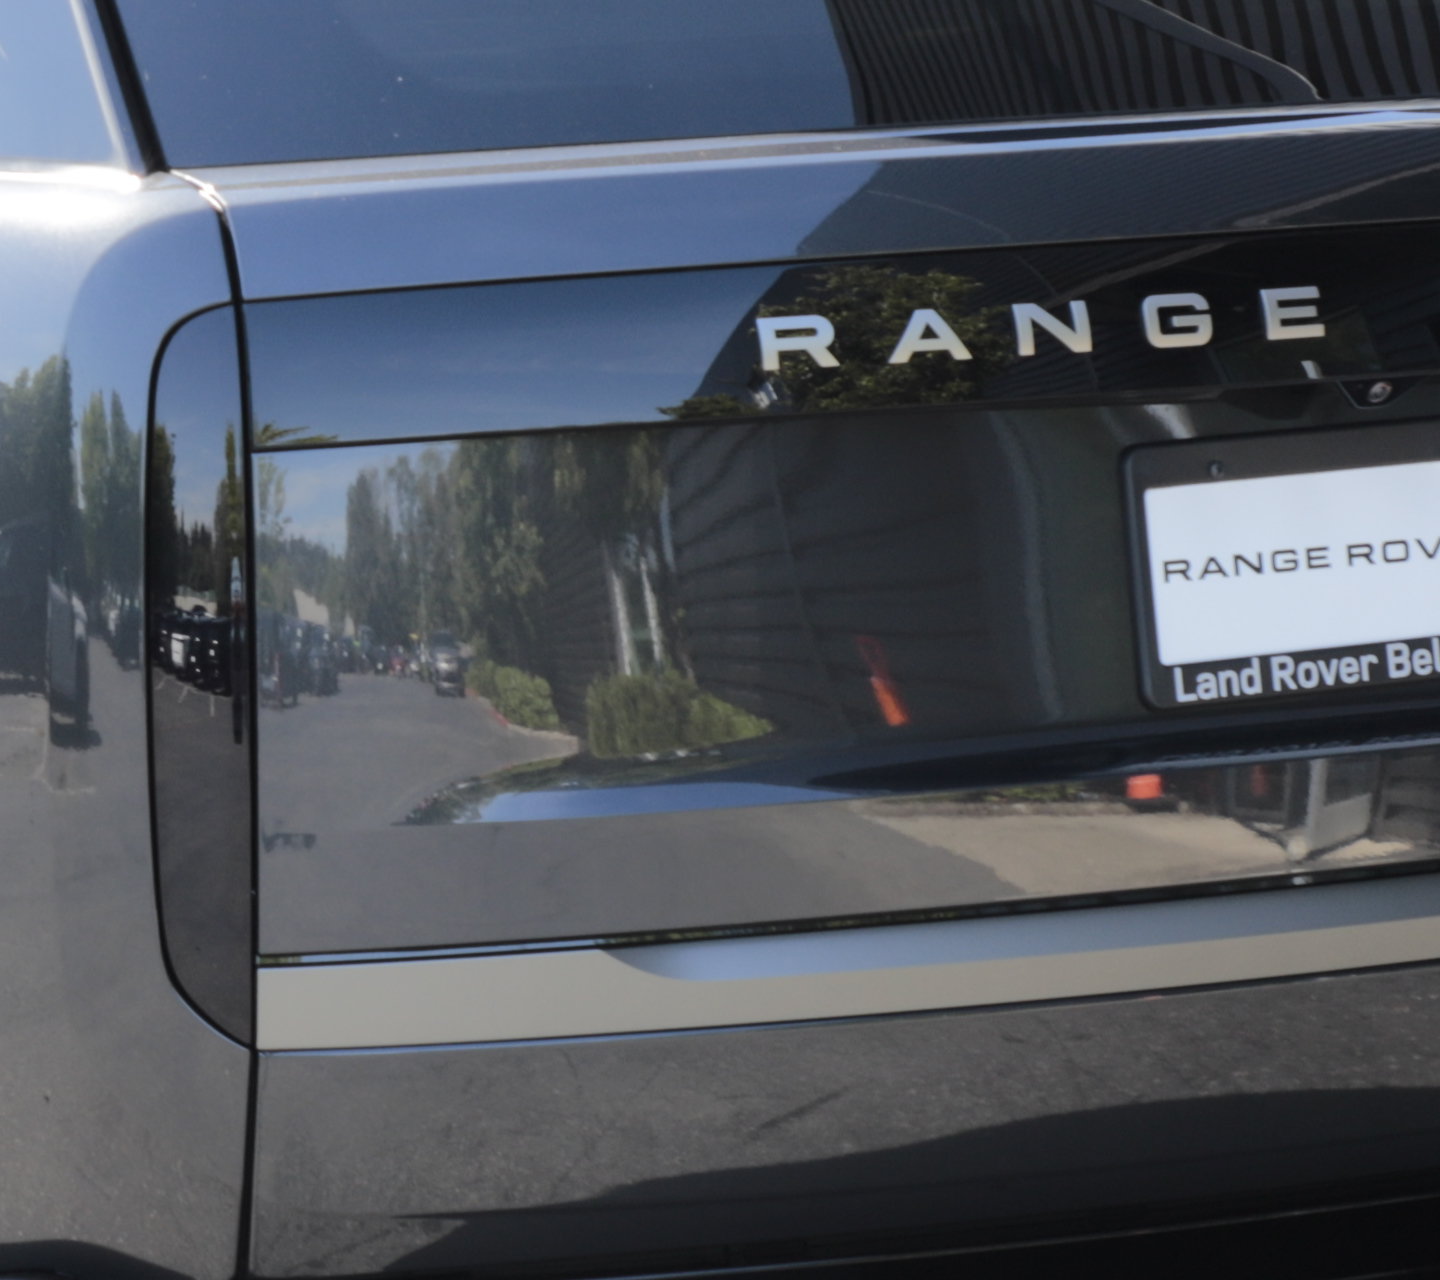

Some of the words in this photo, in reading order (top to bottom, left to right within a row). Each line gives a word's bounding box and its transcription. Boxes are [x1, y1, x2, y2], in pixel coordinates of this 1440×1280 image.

[756, 285, 1326, 373] RANGE
[1162, 546, 1332, 583] RANGE
[1173, 656, 1262, 704] Land
[1270, 652, 1380, 692] Rover
